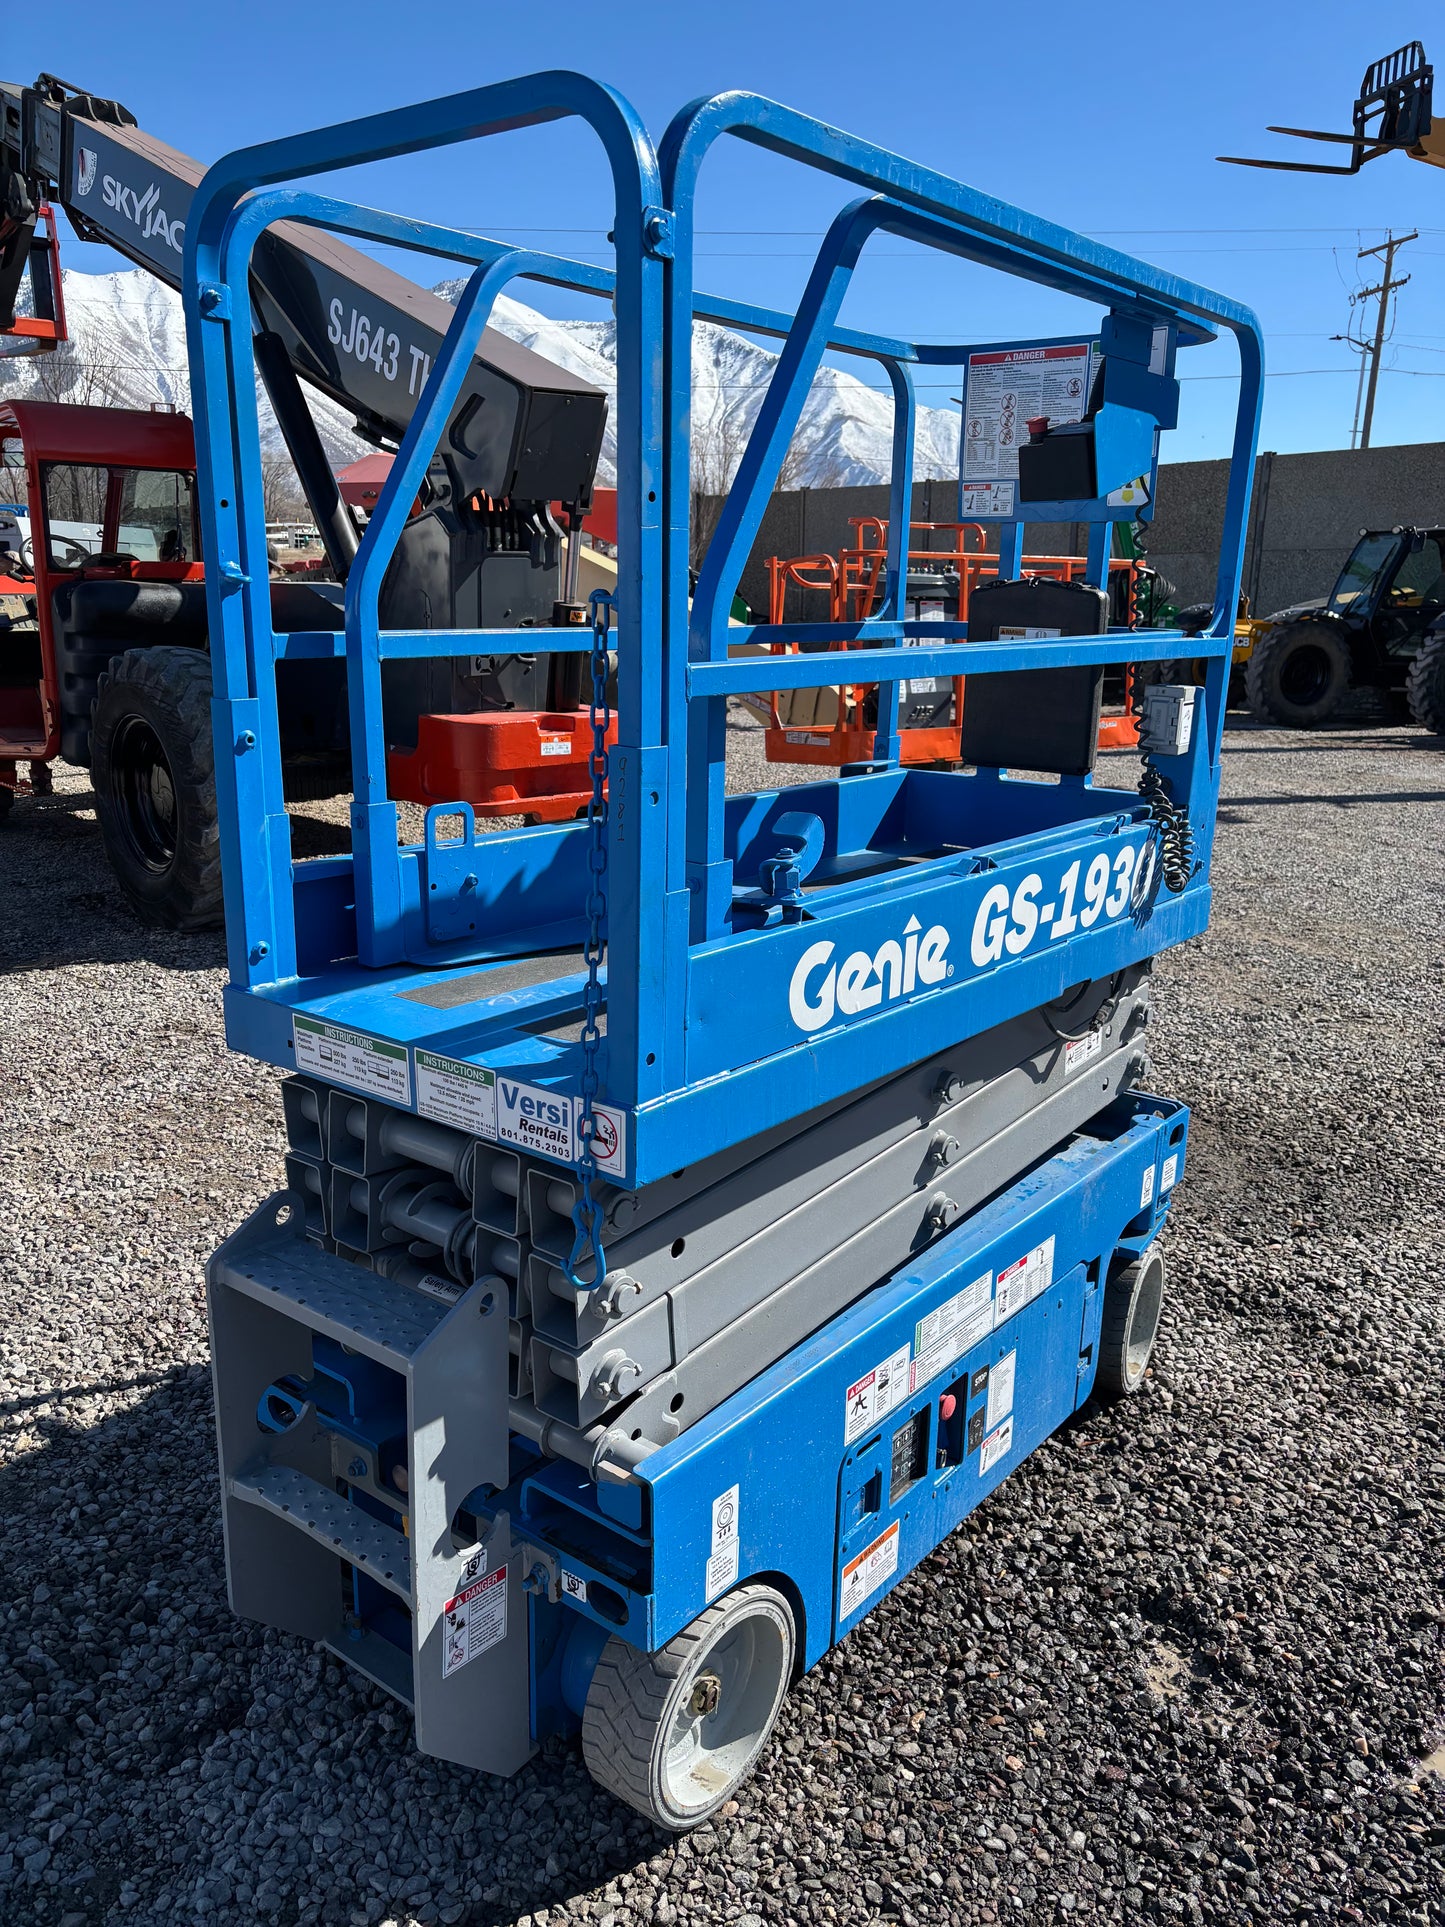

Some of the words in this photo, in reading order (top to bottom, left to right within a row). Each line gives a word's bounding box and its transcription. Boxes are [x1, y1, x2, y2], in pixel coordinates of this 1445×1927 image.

[102, 175, 186, 254] SKYJAC
[327, 298, 400, 381] SJ643
[1013, 350, 1046, 361] DANGER
[789, 914, 950, 1032] Genie
[970, 840, 1157, 968] GS-1930
[324, 1026, 374, 1051] INSTRUCTIONS
[341, 1061, 347, 1069] kg
[423, 1054, 485, 1081] INSTRUCTIONS
[399, 1080, 405, 1088] kg
[501, 1082, 568, 1128] Versi
[501, 1127, 570, 1158] 801.875.2903
[519, 1117, 568, 1145] Rentals
[424, 1276, 444, 1291] Safety
[444, 1283, 460, 1296] Arm
[855, 1373, 875, 1392] DANGER
[974, 1371, 988, 1387] STOP
[465, 1573, 498, 1601] DANGER
